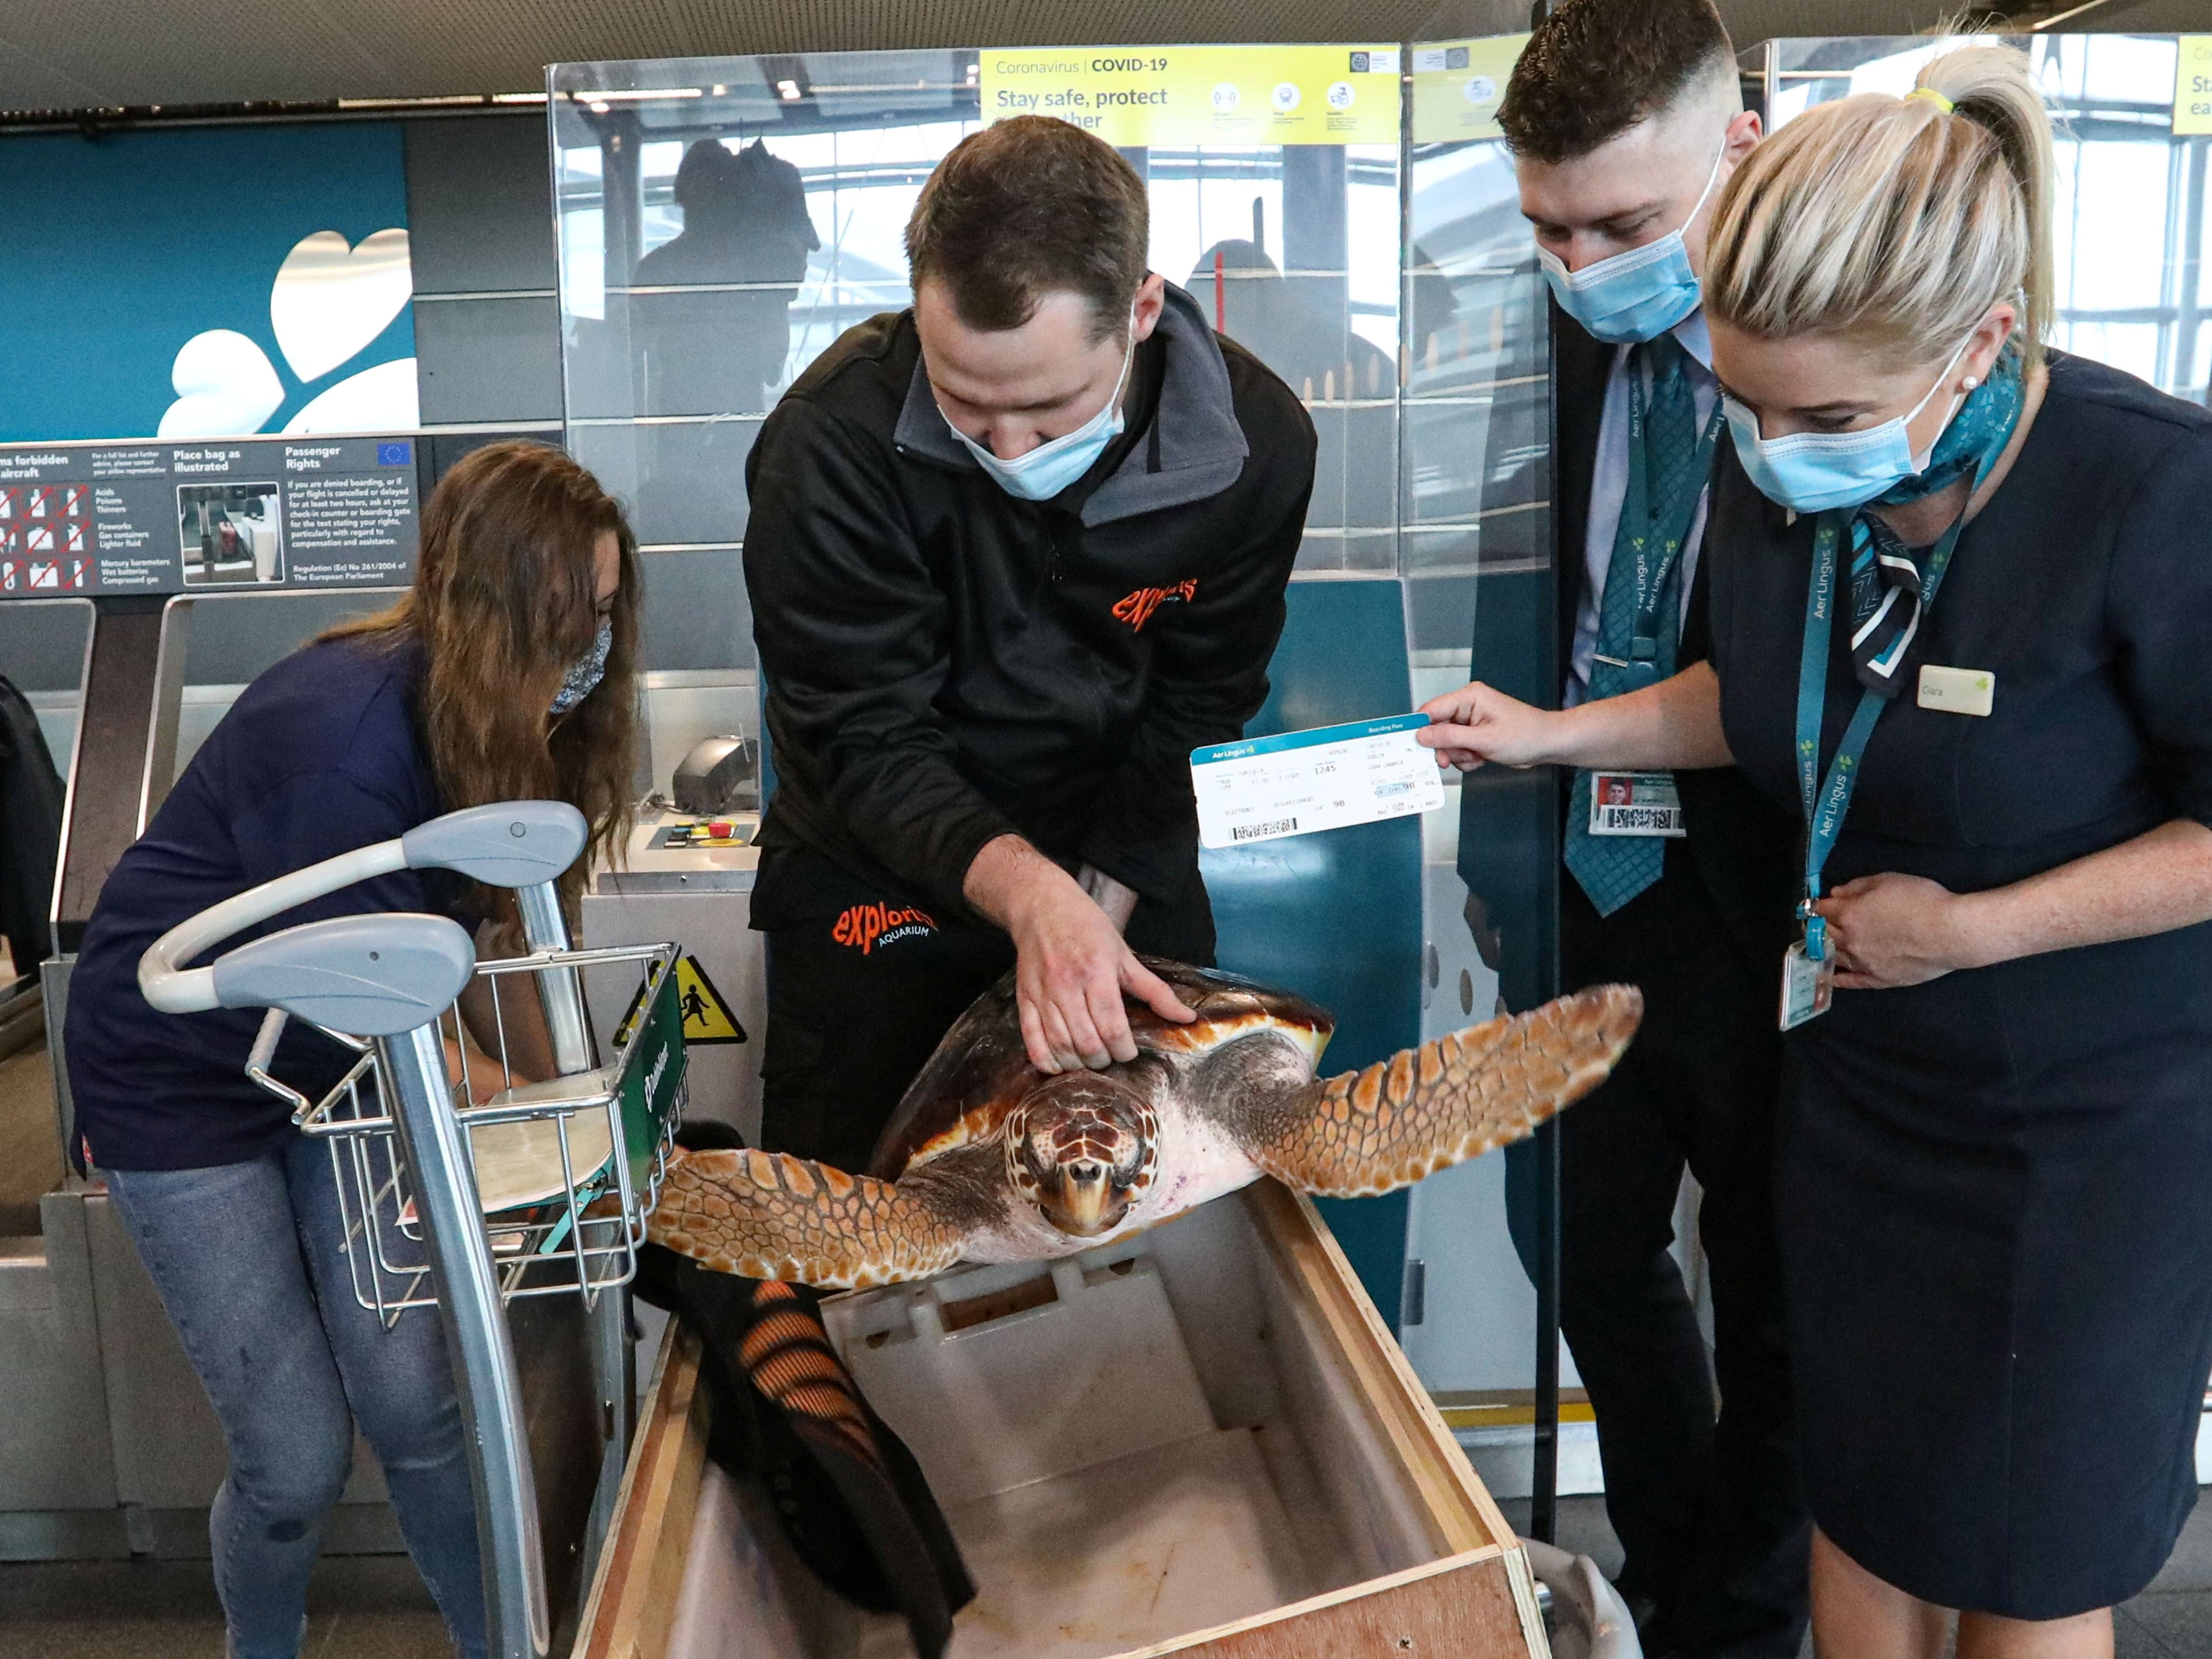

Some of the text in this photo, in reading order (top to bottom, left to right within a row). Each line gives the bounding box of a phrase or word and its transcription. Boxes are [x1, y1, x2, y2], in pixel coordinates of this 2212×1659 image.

[997, 58, 1167, 74] Coronavirus COVID-19
[2192, 76, 2212, 92] St
[997, 89, 1167, 110] Stay safe, protect
[1060, 112, 1102, 128] ther
[1633, 380, 1641, 417] Lingus
[1709, 421, 1722, 443] Aer
[173, 450, 202, 460] Place
[205, 449, 225, 461] bag
[285, 447, 340, 458] Passenger
[15, 454, 68, 465] forbidden
[286, 459, 320, 471] Rights
[174, 460, 229, 472] illustrated
[1, 466, 39, 478] aircraft
[350, 478, 384, 488] boarding,
[289, 492, 305, 500] your
[307, 490, 326, 499] flight
[335, 488, 369, 497] cancelled
[380, 487, 408, 497] delayed
[345, 498, 368, 507] hours,
[290, 510, 319, 518] check-in
[360, 508, 392, 517] boarding
[98, 522, 132, 530] Fireworks
[291, 520, 301, 528] for
[333, 519, 357, 529] stating
[378, 518, 400, 527] rights,
[291, 529, 331, 539] particularly
[350, 528, 374, 538] regard
[99, 540, 124, 549] Lighter
[292, 539, 341, 548] compensation
[359, 538, 397, 546] assistance.
[101, 560, 129, 568] Mercury
[293, 564, 332, 574] Regulation
[333, 563, 346, 572] (Ec)
[102, 576, 145, 585] Compressed
[309, 573, 343, 582] European
[1637, 554, 1648, 609] er Lingus
[1646, 557, 1669, 613] Aer Lingus
[1814, 549, 1833, 619] Aer Lingus
[1368, 725, 1392, 733] Boarding
[1225, 748, 1246, 758] Lingus
[1315, 765, 1336, 775] 1245
[1403, 782, 1415, 791] 9B
[1333, 800, 1345, 809] 9B
[1819, 774, 1847, 838] Aer Lingus
[878, 926, 929, 947] AQUARIUM
